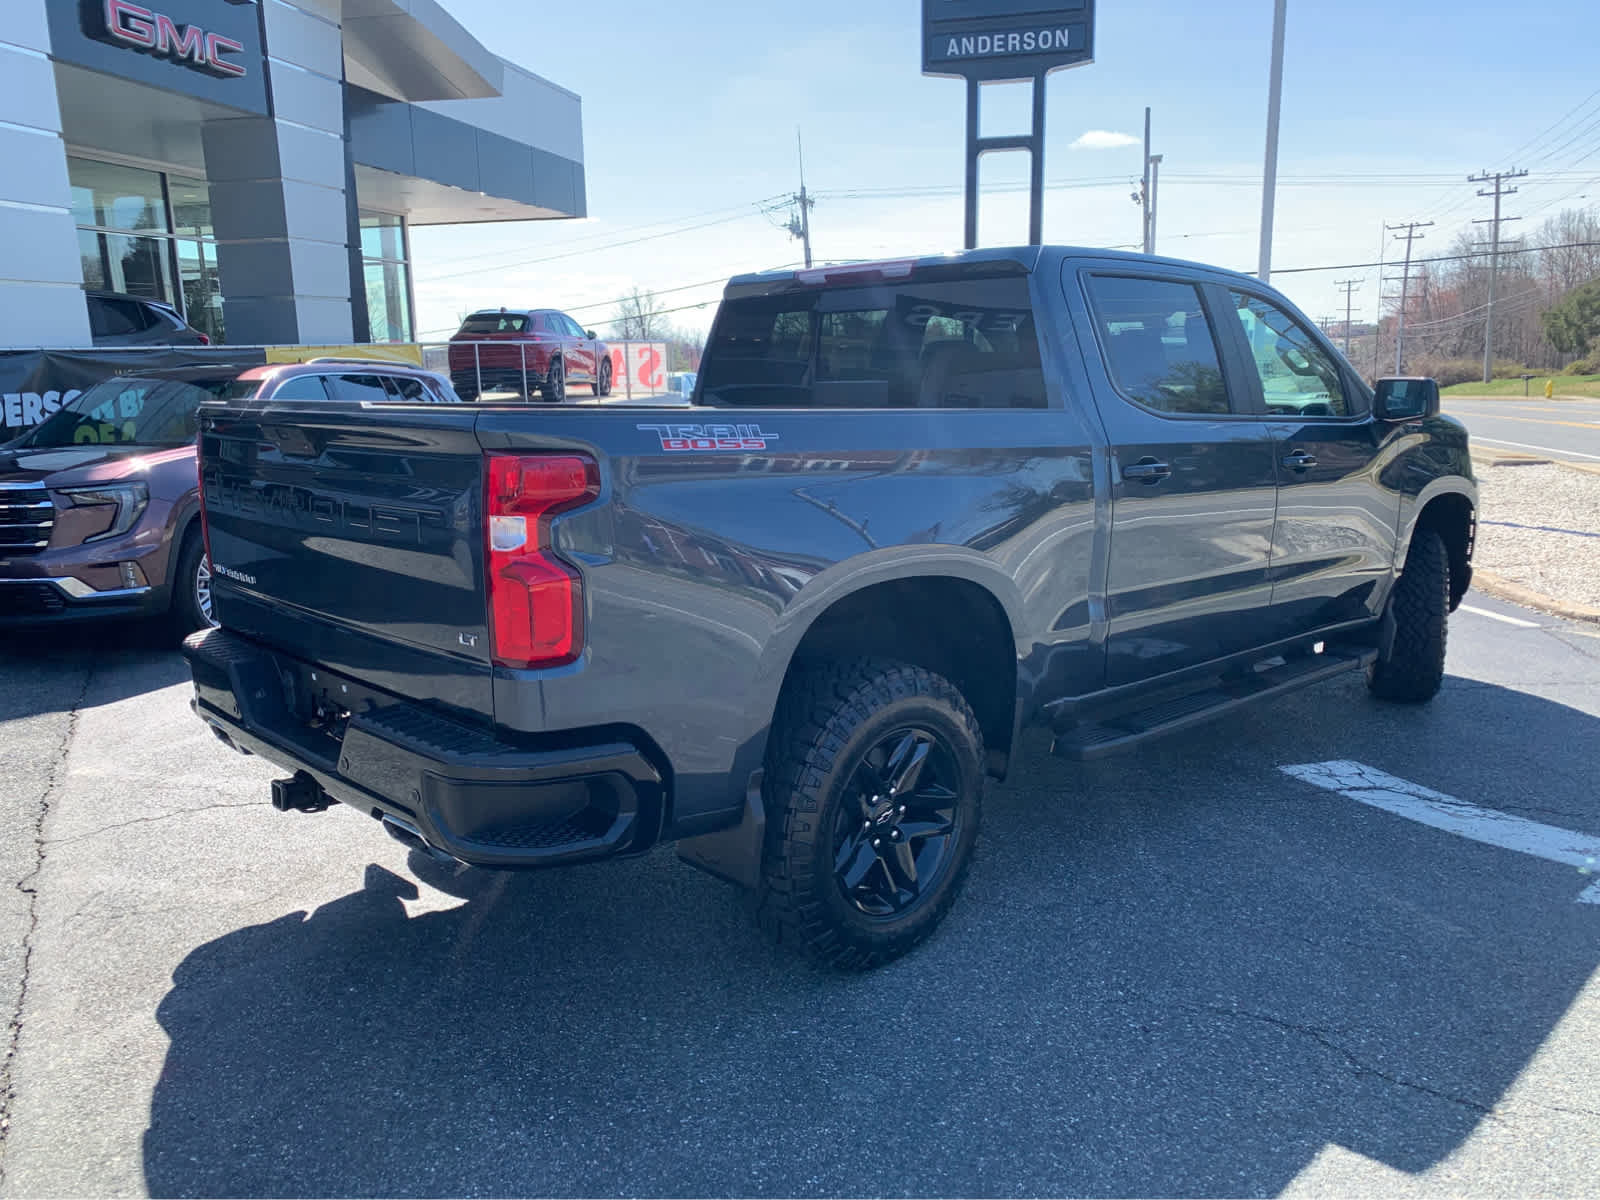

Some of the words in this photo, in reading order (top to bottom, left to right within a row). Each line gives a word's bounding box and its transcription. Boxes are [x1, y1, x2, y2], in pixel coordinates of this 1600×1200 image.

[104, 0, 247, 76] GMC
[946, 28, 1070, 56] ANDERSON
[636, 423, 779, 440] TRAIL
[661, 438, 766, 451] BOSS
[458, 631, 479, 648] LT
